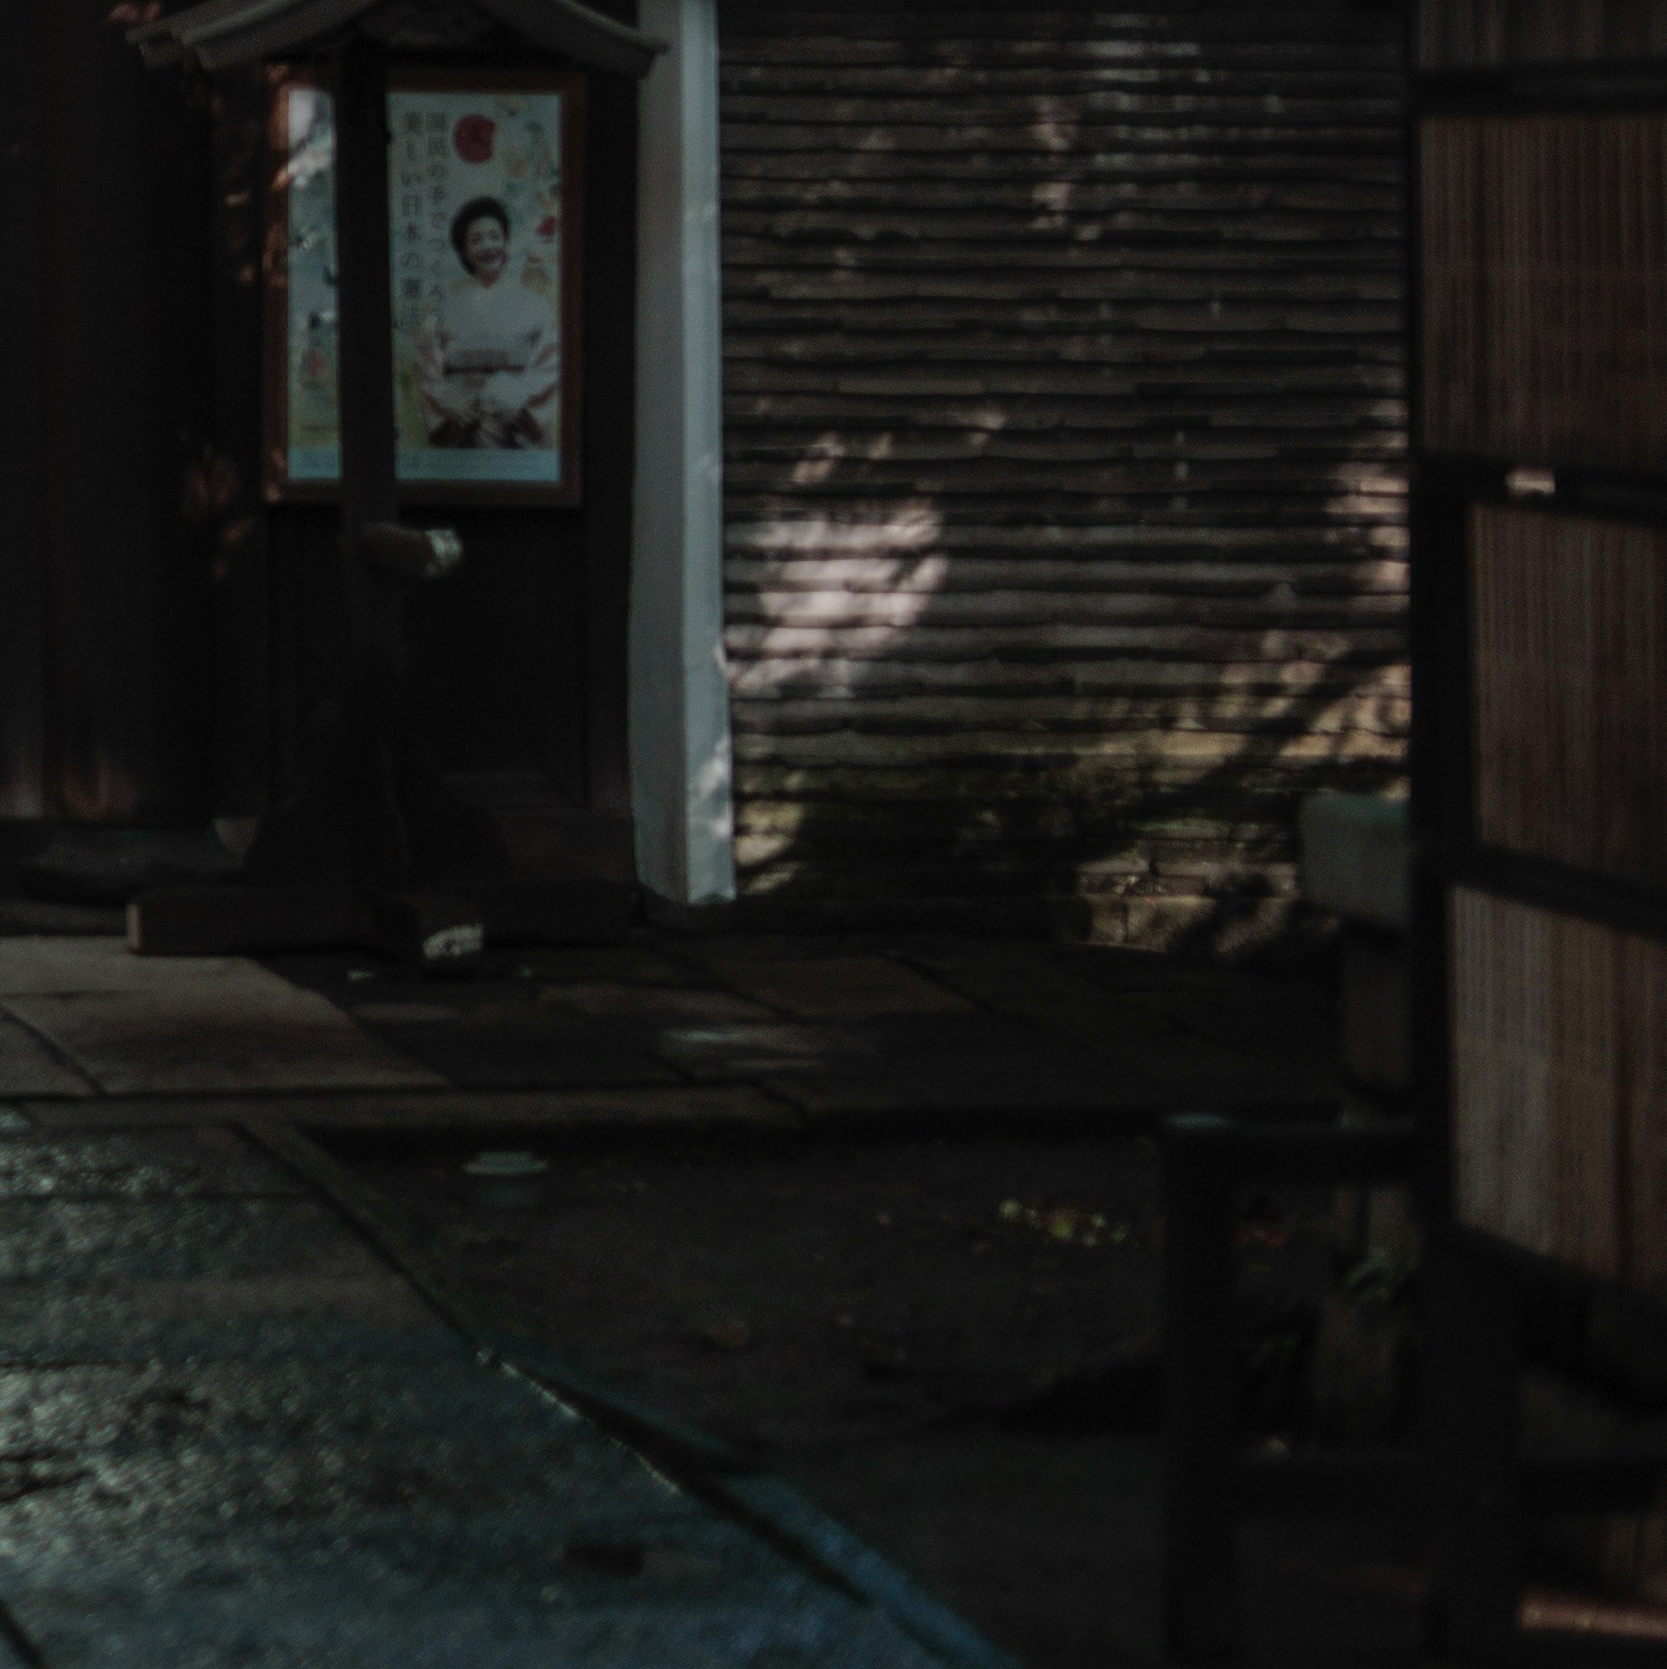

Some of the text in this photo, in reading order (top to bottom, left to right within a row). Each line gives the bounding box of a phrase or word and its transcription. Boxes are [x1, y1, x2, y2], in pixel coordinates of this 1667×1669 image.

[400, 112, 423, 329] 美しい日本の憲法
